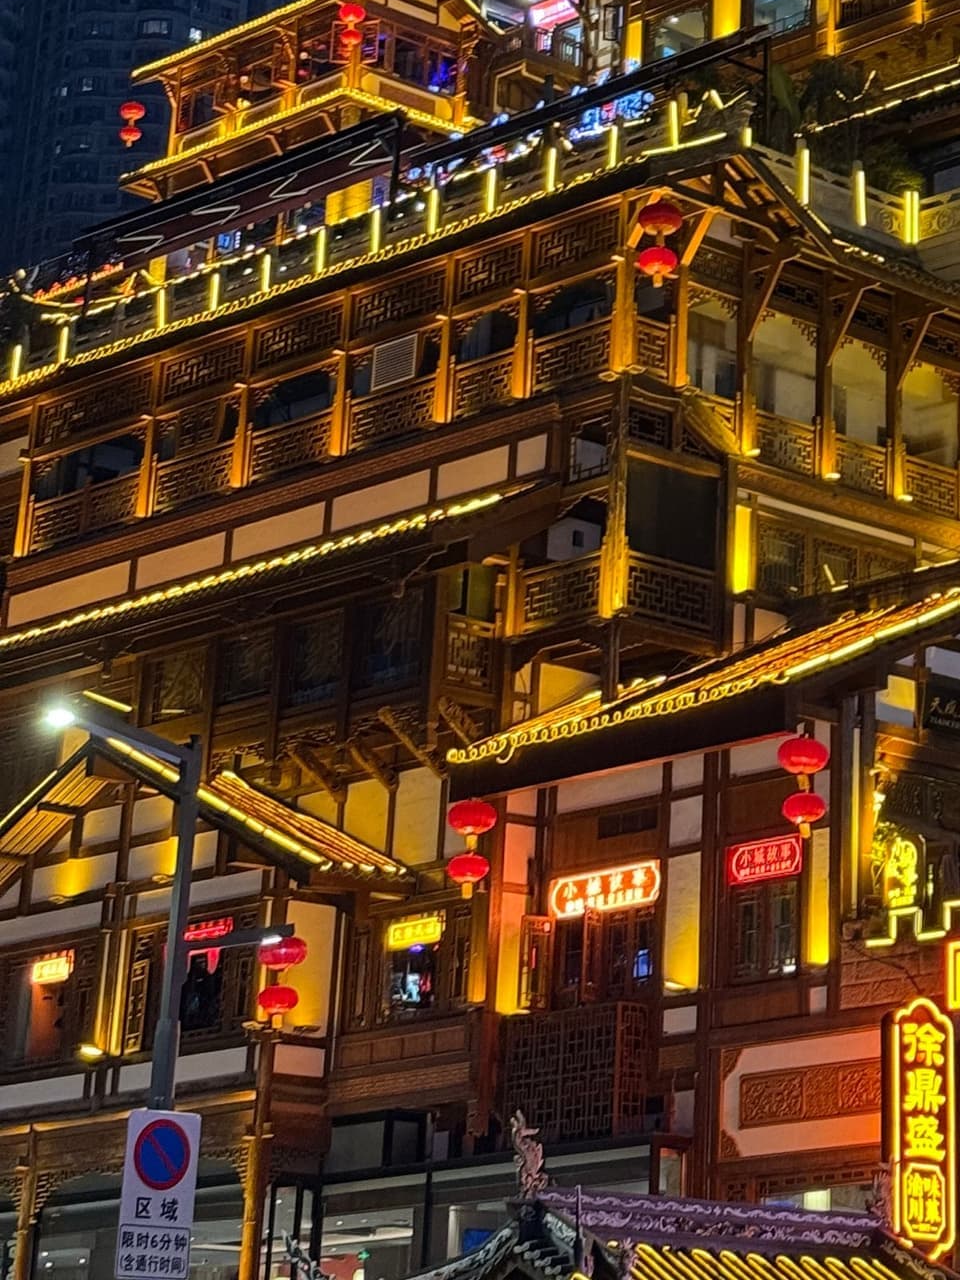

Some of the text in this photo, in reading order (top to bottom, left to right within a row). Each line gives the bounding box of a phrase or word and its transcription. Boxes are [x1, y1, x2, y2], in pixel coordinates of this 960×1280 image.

[903, 1022, 946, 1162] 徐鼎盛
[135, 1196, 179, 1222] 区域
[122, 1230, 187, 1253] 限时6分钟
